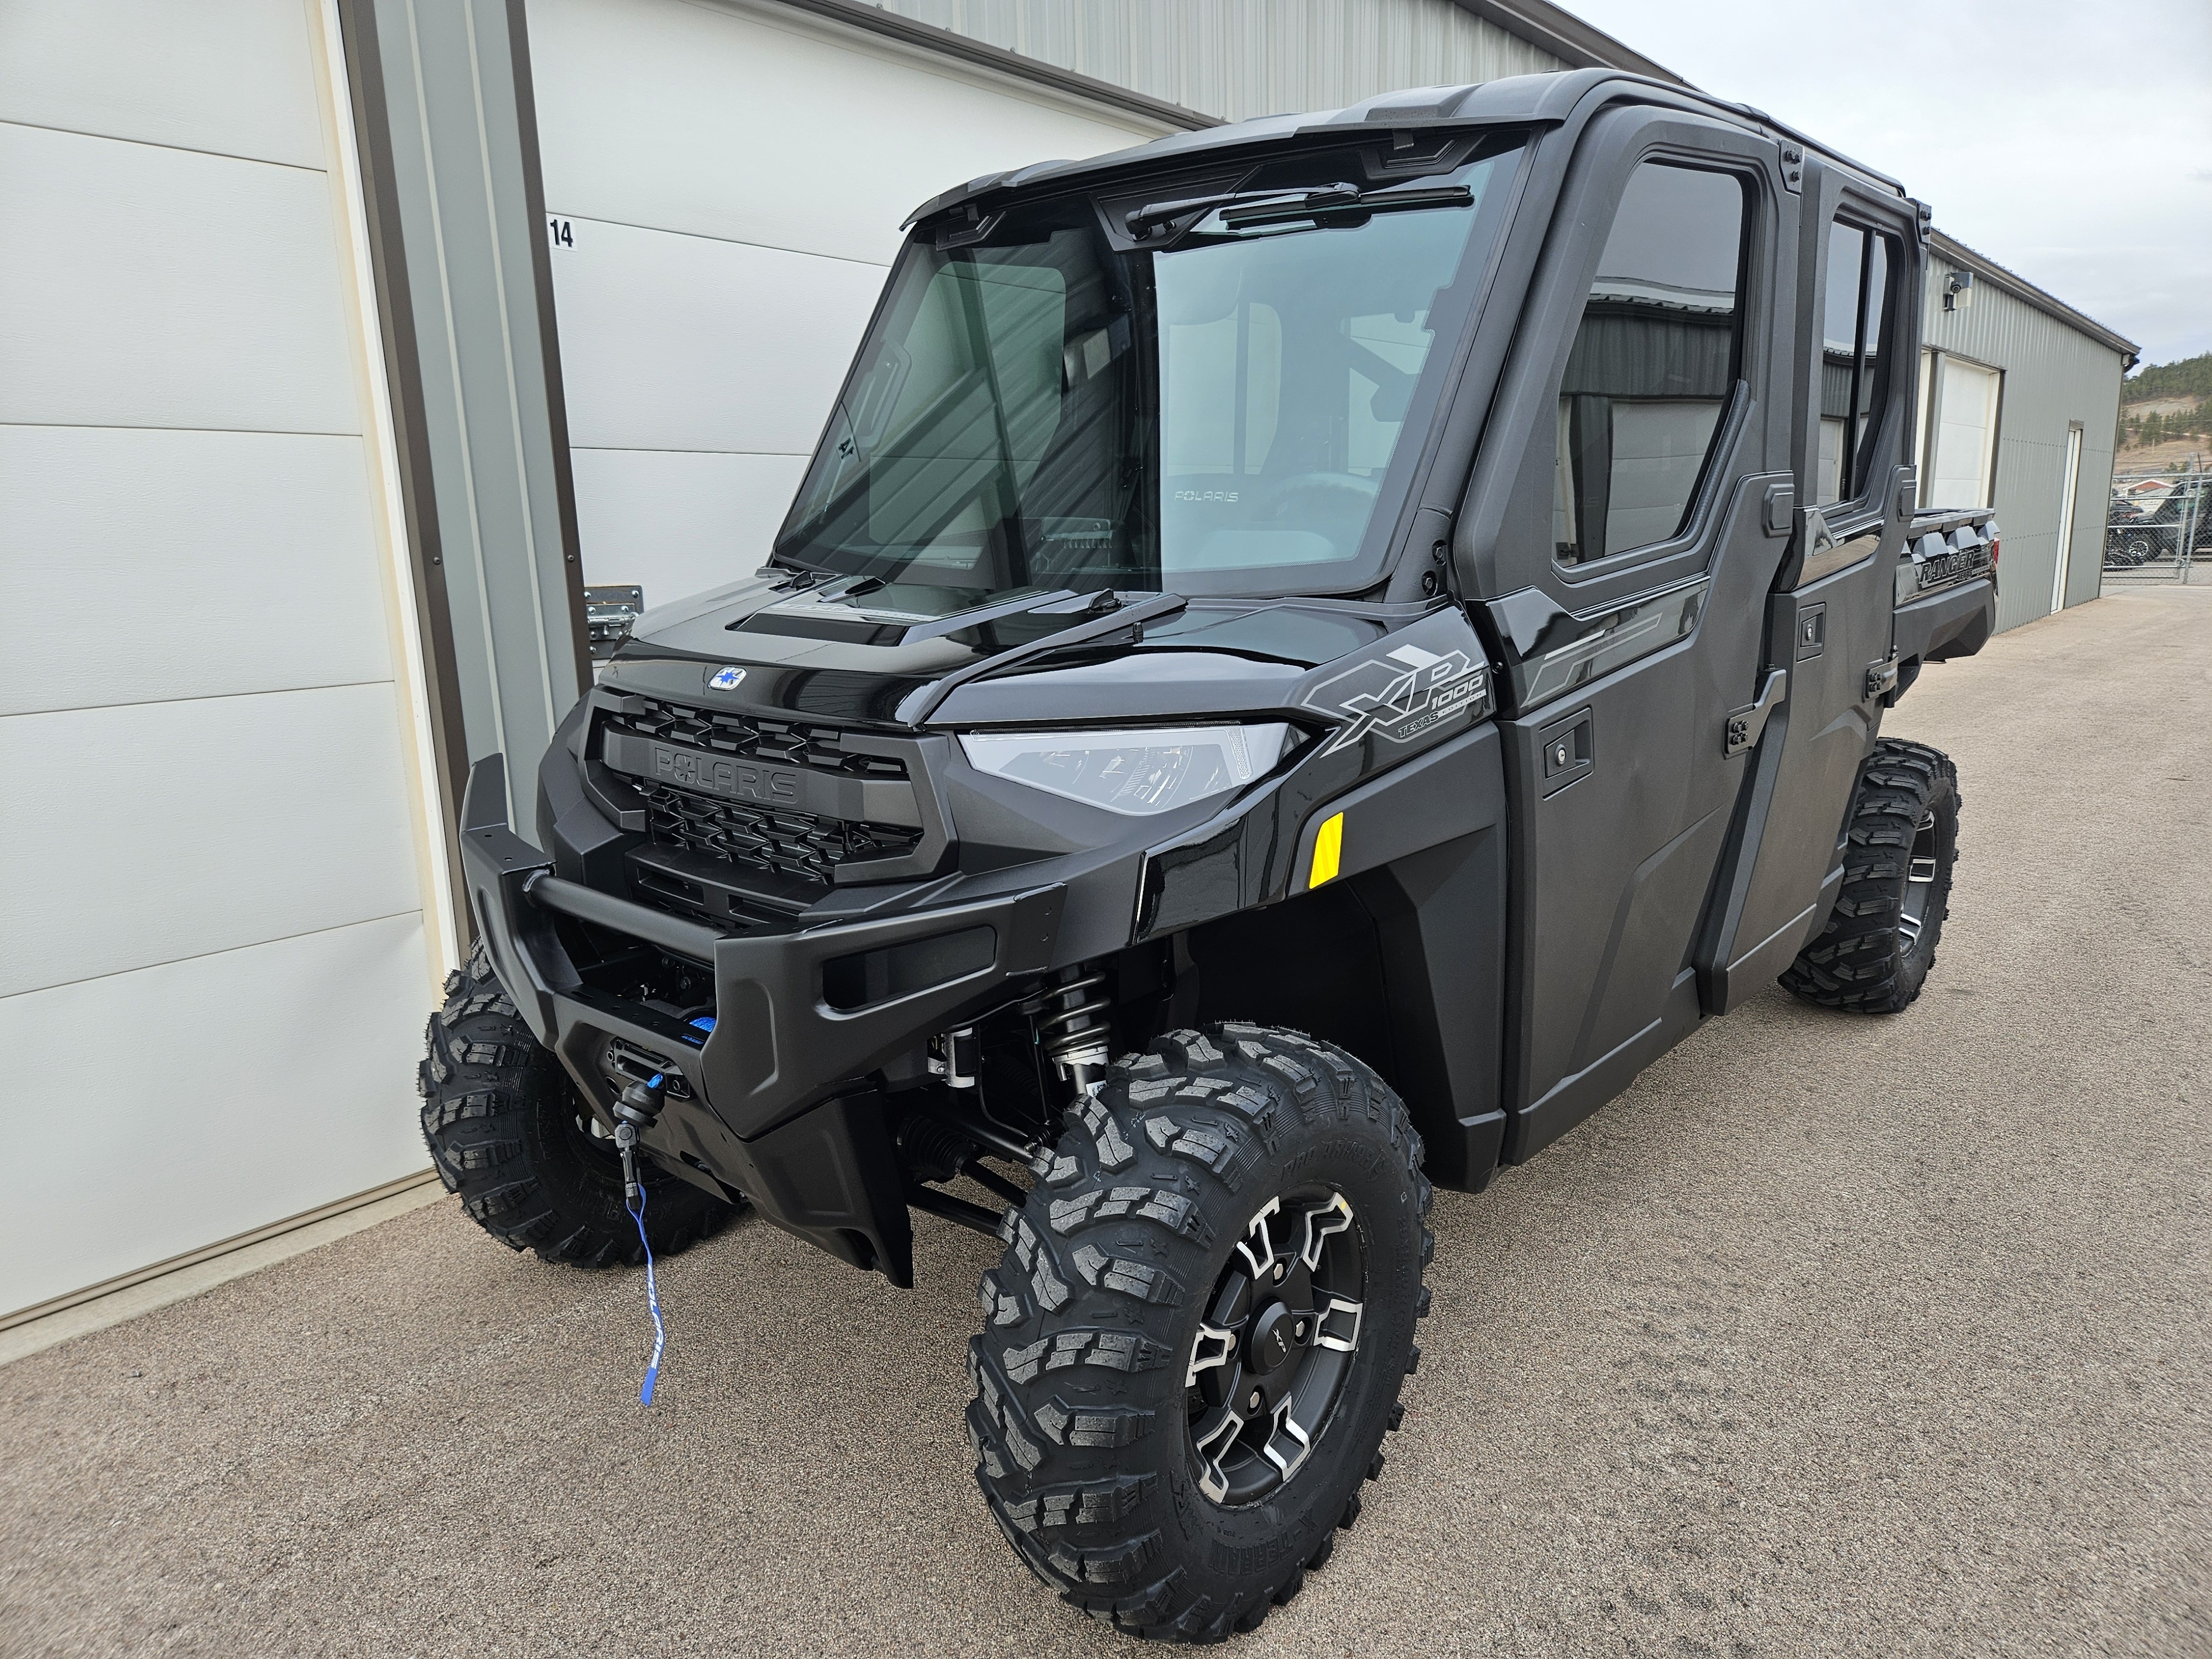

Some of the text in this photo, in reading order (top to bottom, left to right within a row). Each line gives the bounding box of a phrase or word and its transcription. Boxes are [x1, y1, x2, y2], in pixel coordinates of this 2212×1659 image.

[550, 219, 573, 248] 14
[1175, 491, 1239, 503] POLARIS
[1919, 550, 1975, 584] RANGER
[1319, 649, 1485, 758] XP
[1432, 674, 1483, 710] 1000
[1398, 692, 1482, 738] TEXAS EDITION
[655, 747, 798, 804] POLARIS
[648, 1264, 664, 1370] POLARIS
[1272, 1328, 1286, 1353] XP
